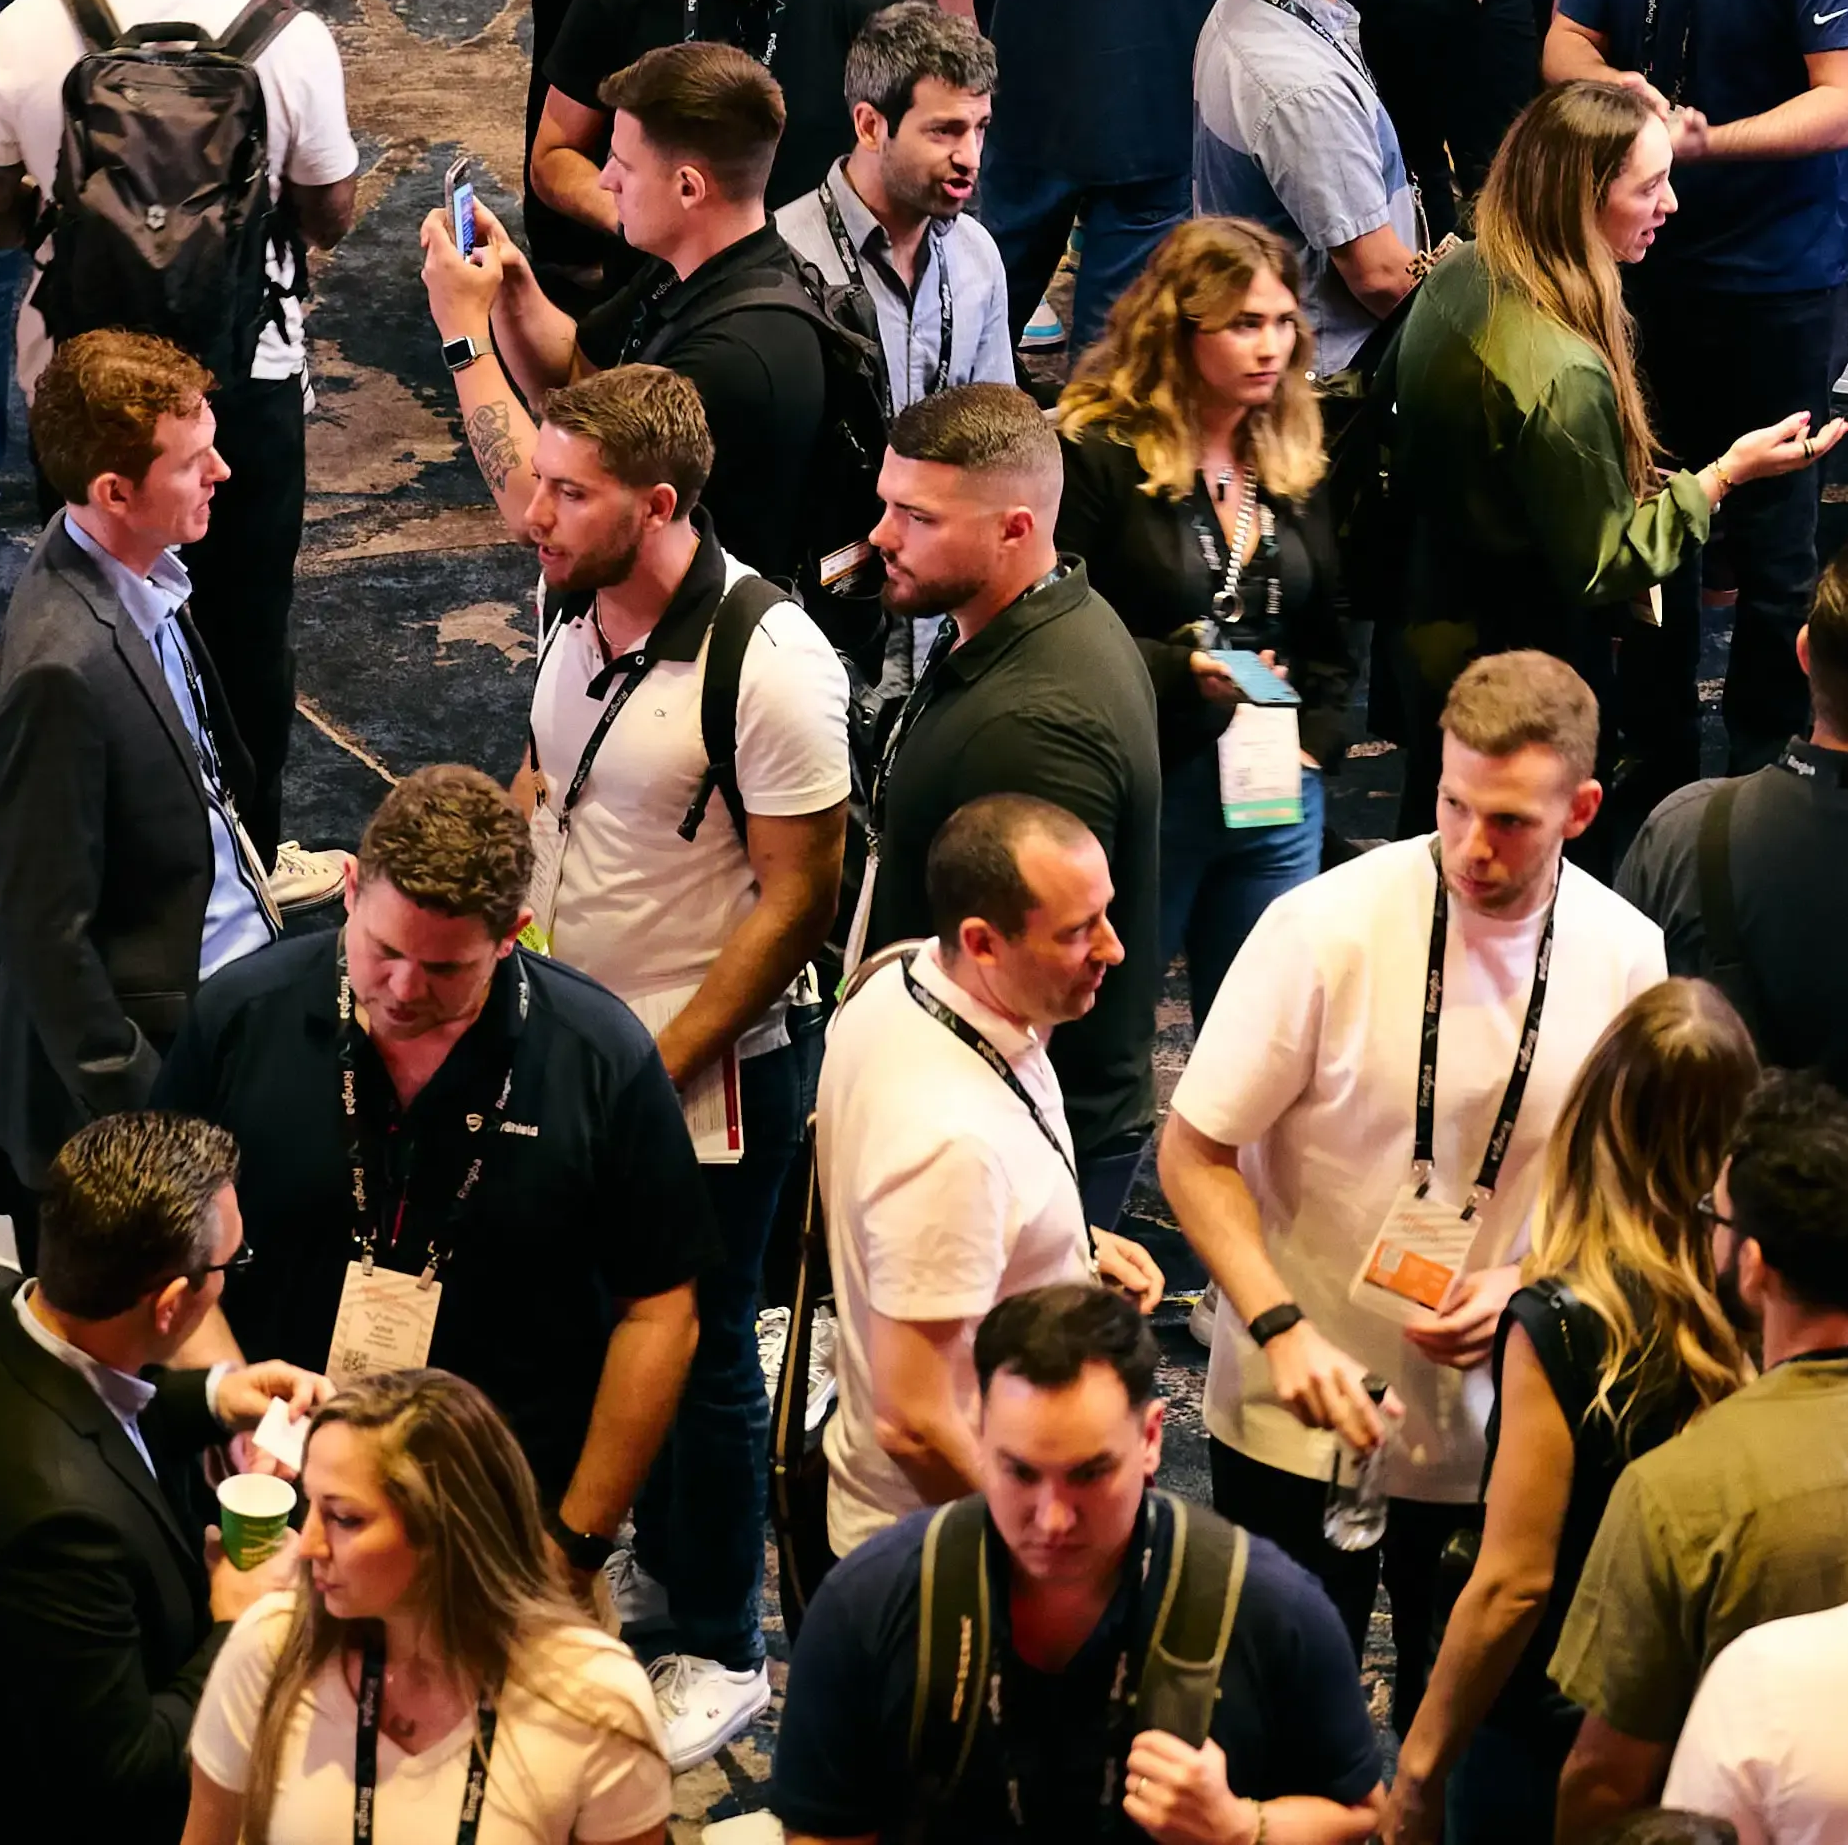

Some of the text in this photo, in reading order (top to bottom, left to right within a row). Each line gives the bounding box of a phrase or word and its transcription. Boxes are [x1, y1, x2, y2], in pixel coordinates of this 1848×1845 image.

[605, 690, 628, 723] Ringba
[337, 976, 350, 1020] Ringba
[1426, 969, 1440, 1013] Ringba
[342, 1070, 356, 1115] Ringba
[1420, 1065, 1435, 1107] Ringba
[352, 1167, 366, 1212] Ringba
[456, 1159, 482, 1200] Ringba
